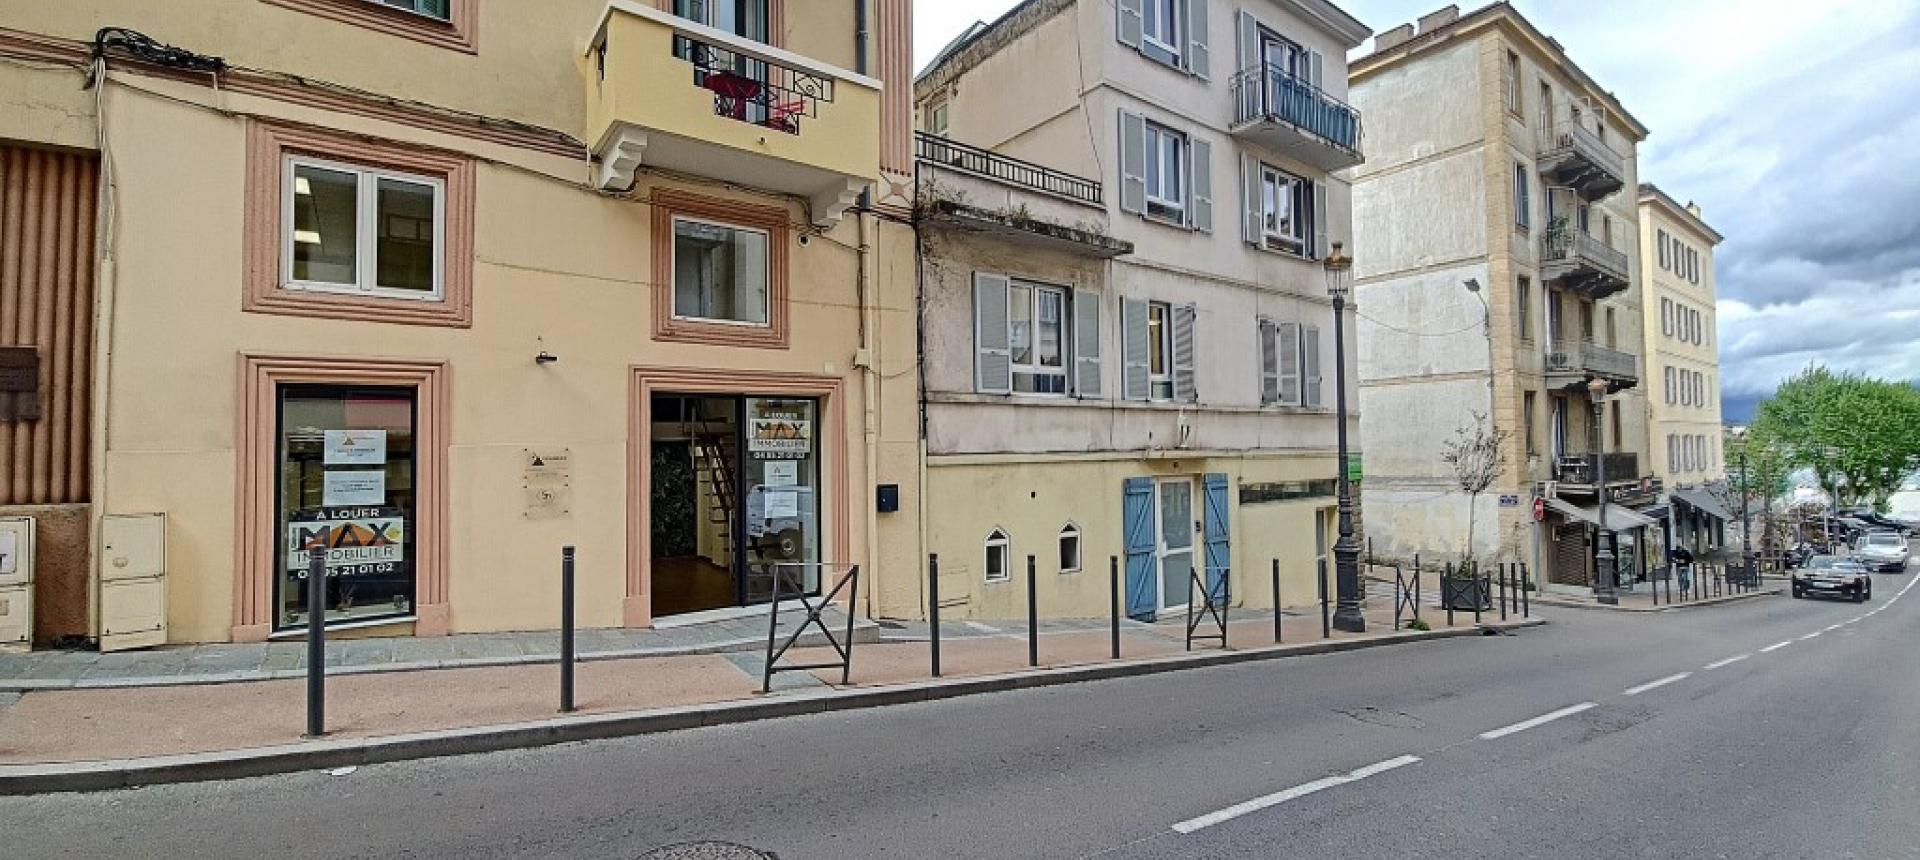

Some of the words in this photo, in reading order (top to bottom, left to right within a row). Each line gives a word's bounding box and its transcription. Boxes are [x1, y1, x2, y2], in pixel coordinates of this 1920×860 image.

[756, 421, 806, 440] MAX
[753, 440, 805, 448] IMMOBILIER
[331, 508, 380, 519] LOUER
[299, 522, 400, 550] MAX
[342, 566, 355, 575] 21
[359, 564, 374, 574] 01
[376, 562, 394, 573] 02
